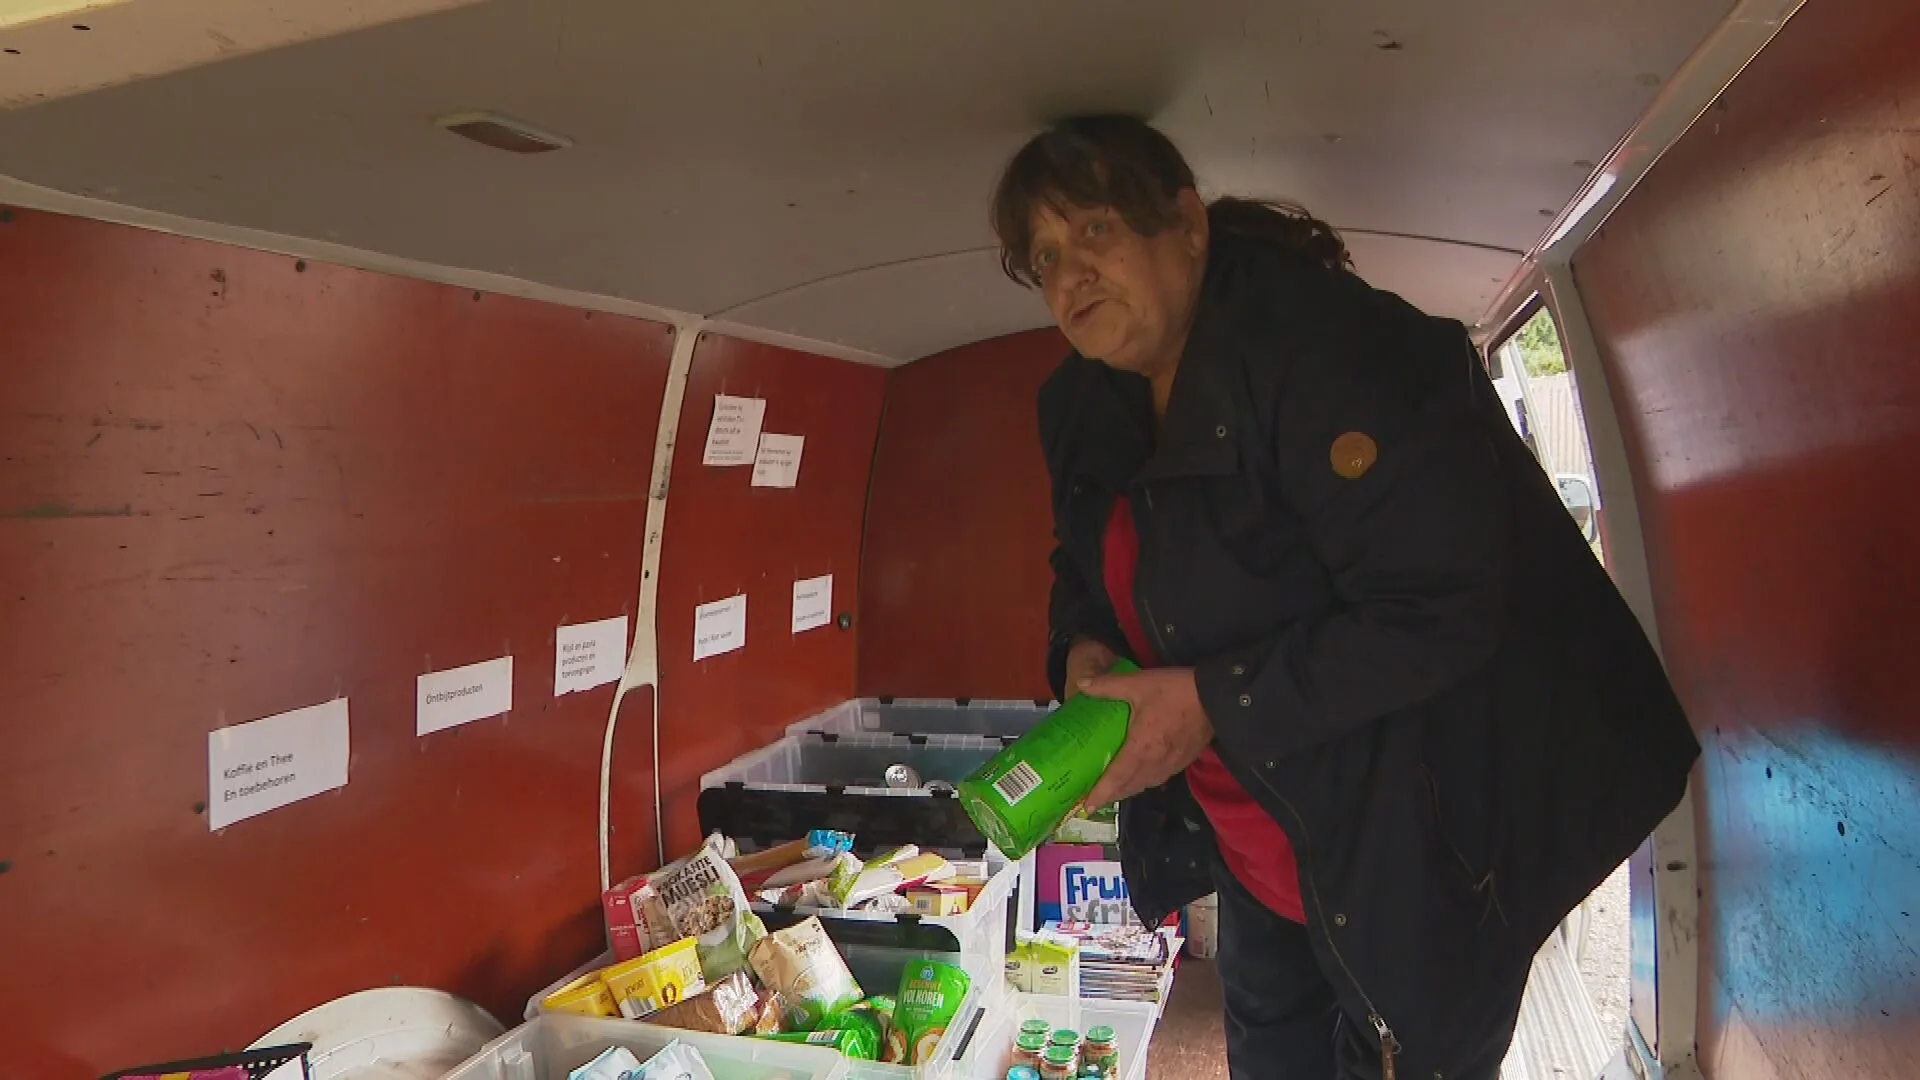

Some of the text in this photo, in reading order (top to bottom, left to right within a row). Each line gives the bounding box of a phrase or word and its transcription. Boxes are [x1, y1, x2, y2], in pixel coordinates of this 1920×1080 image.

[425, 684, 483, 705] Ontbijtproducten
[223, 753, 293, 779] Koffie en Thee
[223, 773, 296, 802] En toebehoren
[661, 866, 721, 909] MUESLI
[903, 988, 945, 1009] VOLKOREN
